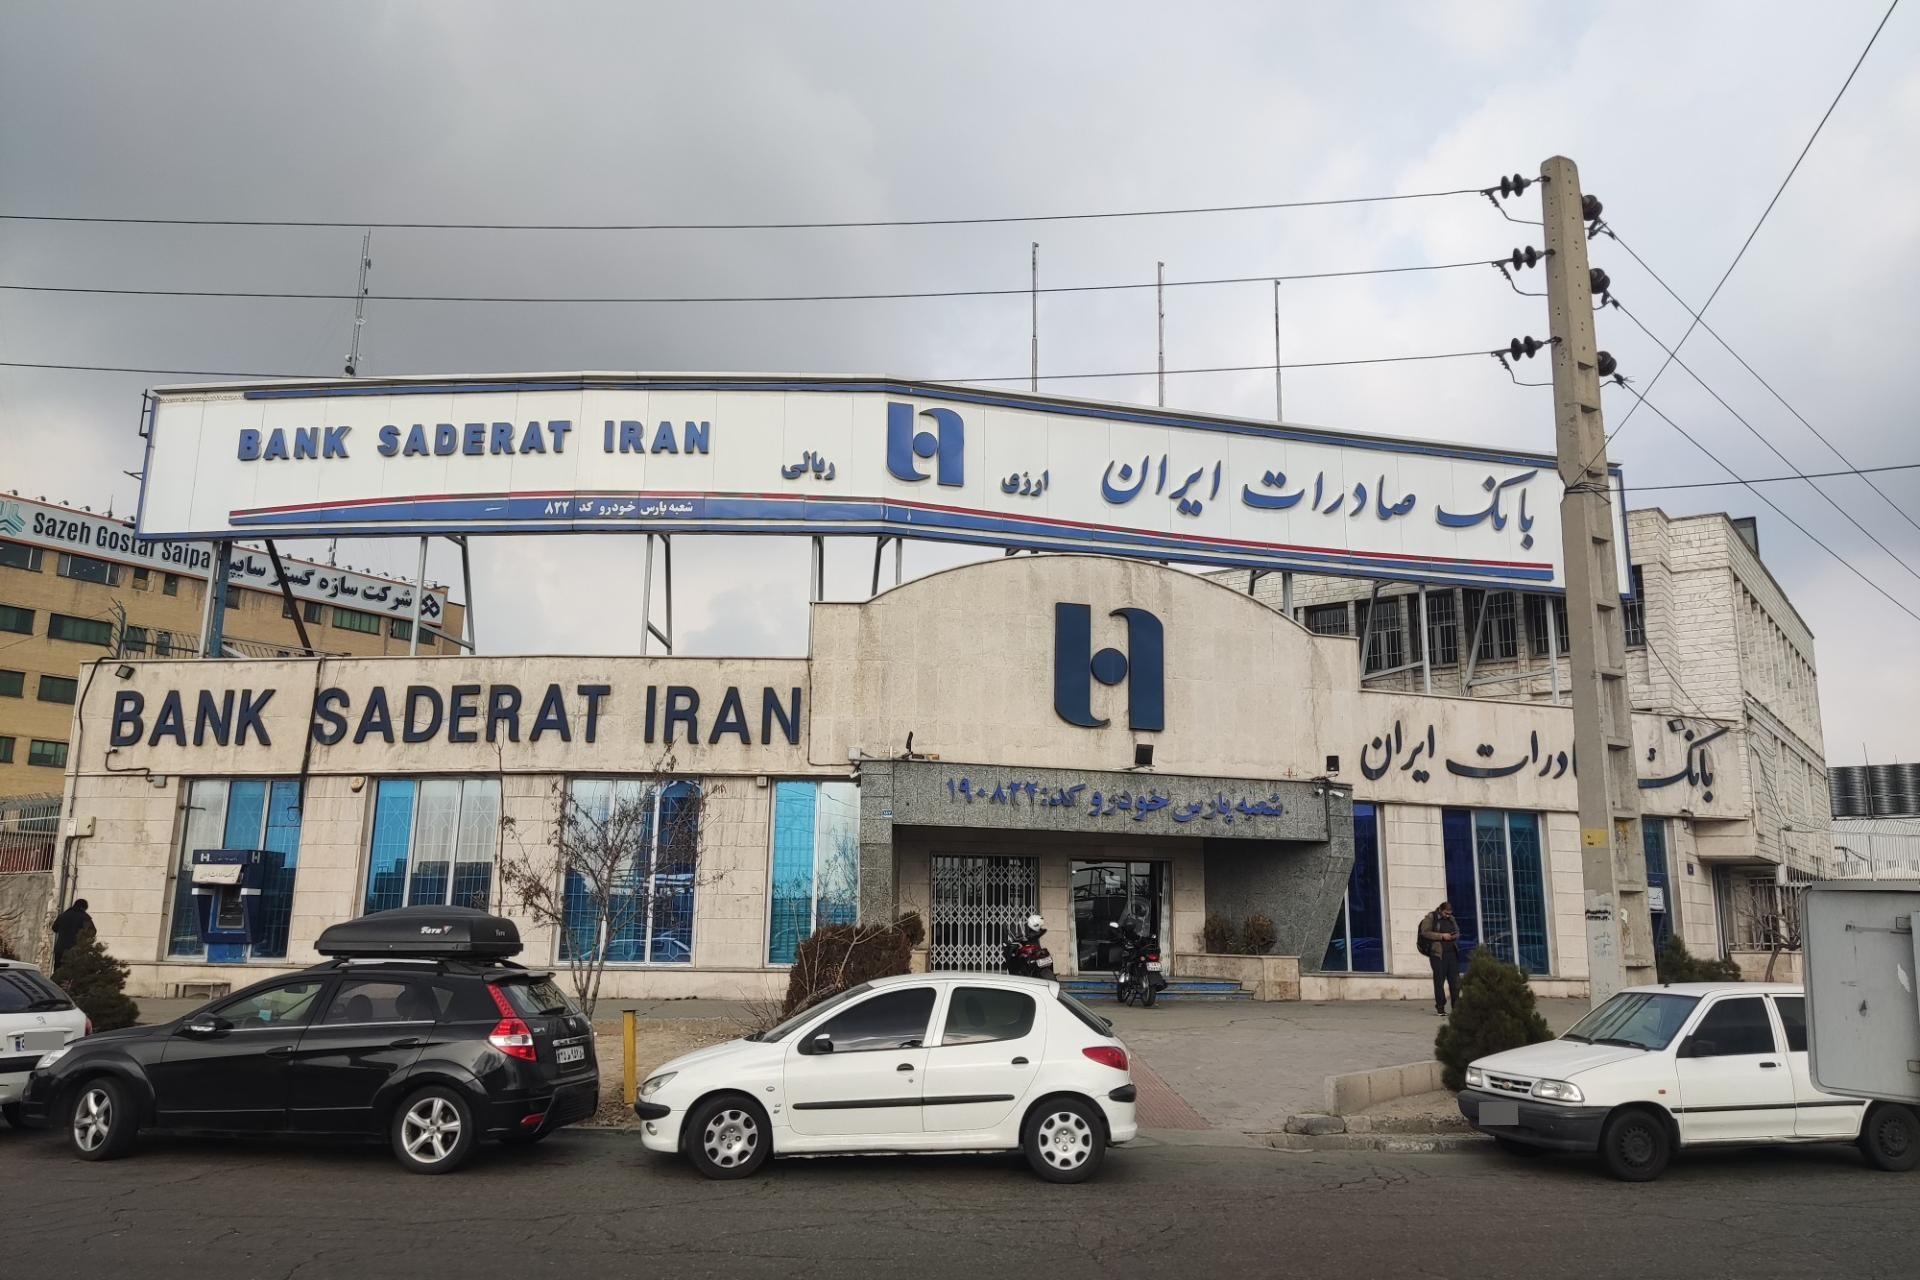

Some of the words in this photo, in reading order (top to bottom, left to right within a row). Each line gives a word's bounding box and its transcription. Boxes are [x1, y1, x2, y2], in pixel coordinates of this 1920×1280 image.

[237, 425, 352, 462] BANK
[376, 420, 573, 458] SADERAT
[602, 420, 711, 455] IRAN
[780, 449, 836, 481] ریالی
[1000, 468, 1050, 498] ارزی
[1099, 452, 1222, 518] ایران
[1240, 468, 1417, 521] صادرات
[577, 500, 595, 513] کد
[598, 499, 637, 516] خودرو
[639, 499, 668, 517] پارس
[667, 500, 695, 514] شعبه
[1434, 468, 1540, 551] بانک
[32, 511, 92, 545] Sazeh
[161, 541, 211, 570] Saipa
[318, 575, 359, 598] سازه
[362, 585, 413, 611] شرکت
[109, 688, 277, 747] BANK
[312, 683, 612, 746] SADERAT
[643, 685, 803, 746] IRAN
[1360, 719, 1435, 784] ایران
[1086, 788, 1170, 822] خودرو
[1171, 790, 1231, 826] پارس
[1235, 792, 1284, 822] شعبه
